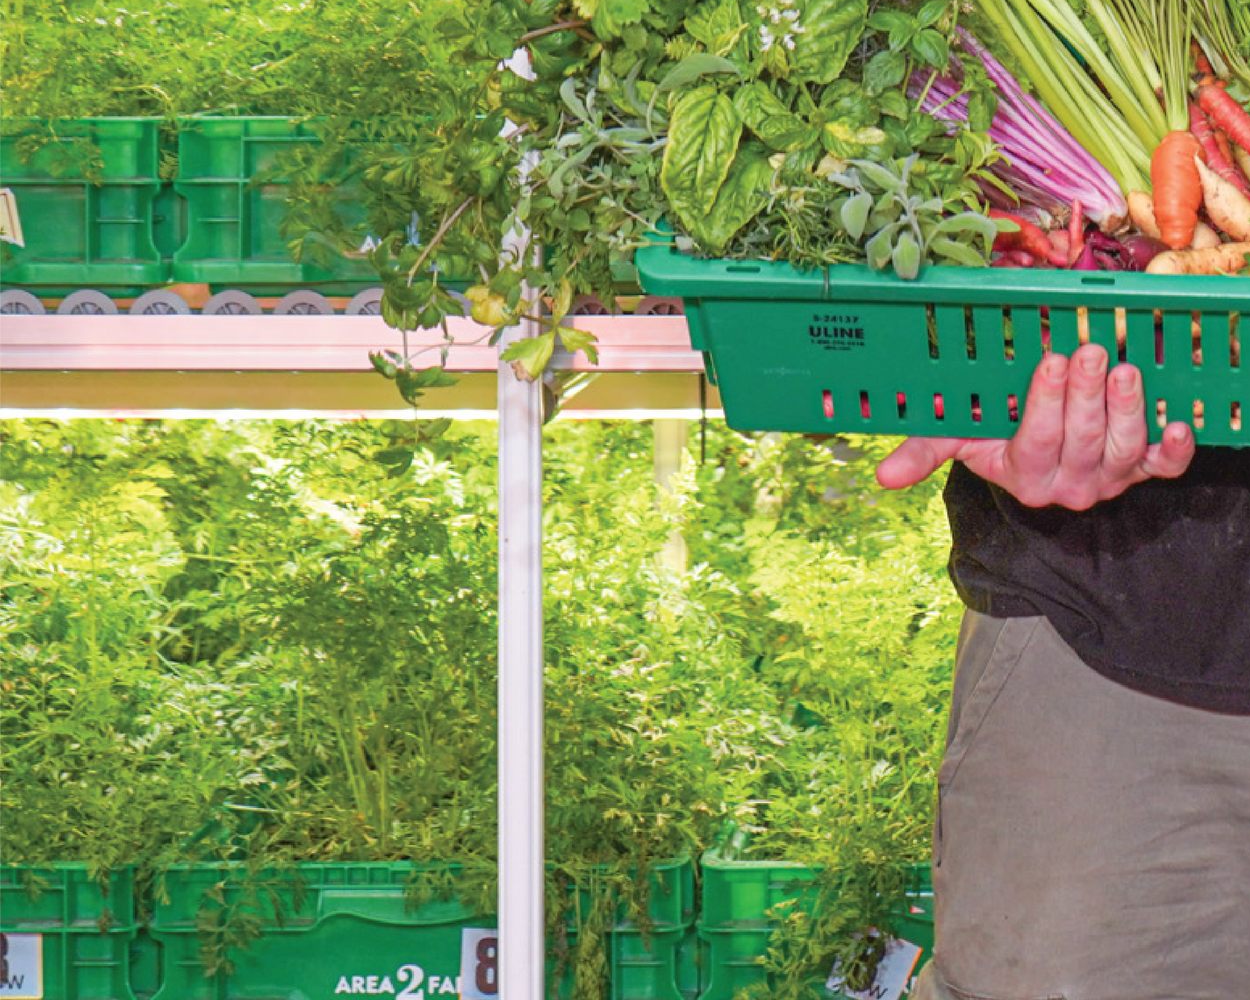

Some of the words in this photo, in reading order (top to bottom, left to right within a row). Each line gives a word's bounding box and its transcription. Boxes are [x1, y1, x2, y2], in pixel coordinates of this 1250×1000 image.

[809, 325, 866, 339] ULINE
[334, 975, 395, 994] AREA
[395, 963, 424, 1000] 2
